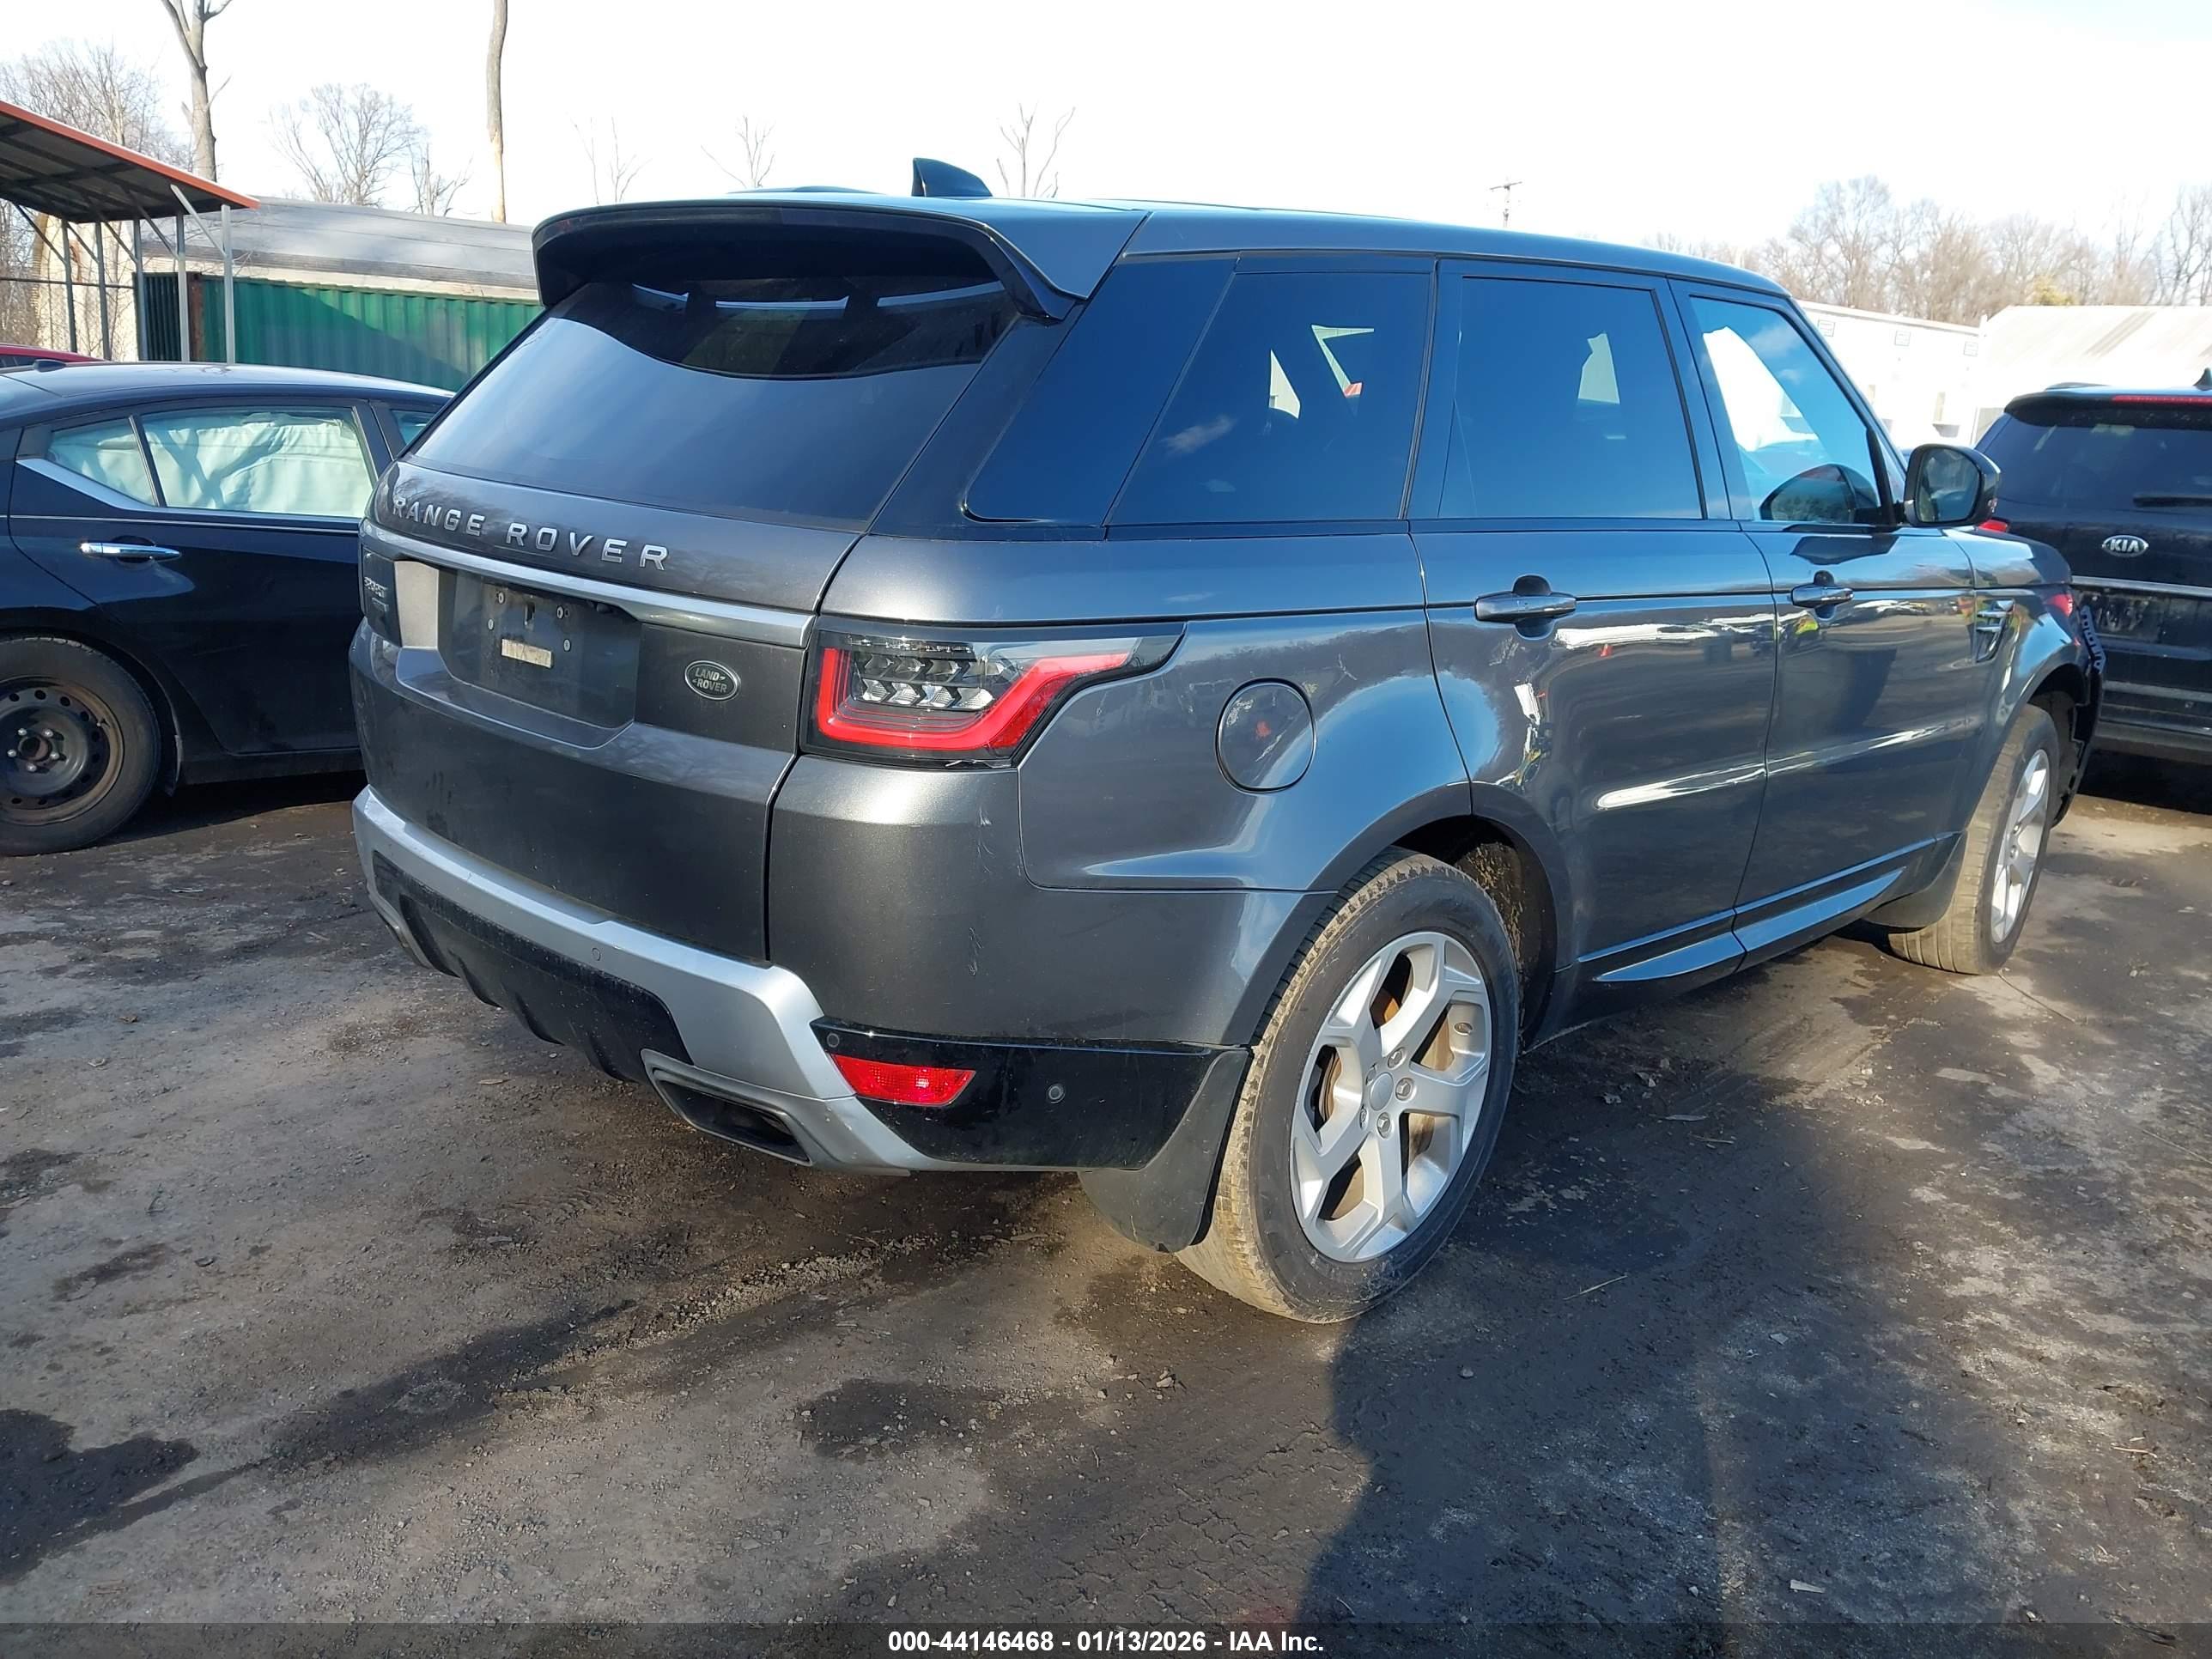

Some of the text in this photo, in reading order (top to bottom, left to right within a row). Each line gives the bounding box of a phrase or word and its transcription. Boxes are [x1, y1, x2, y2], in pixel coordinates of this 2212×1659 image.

[392, 496, 667, 571] RANGE ROVER
[2110, 538, 2139, 552] KIA
[695, 667, 720, 681] LAND
[696, 678, 727, 693] ROVER
